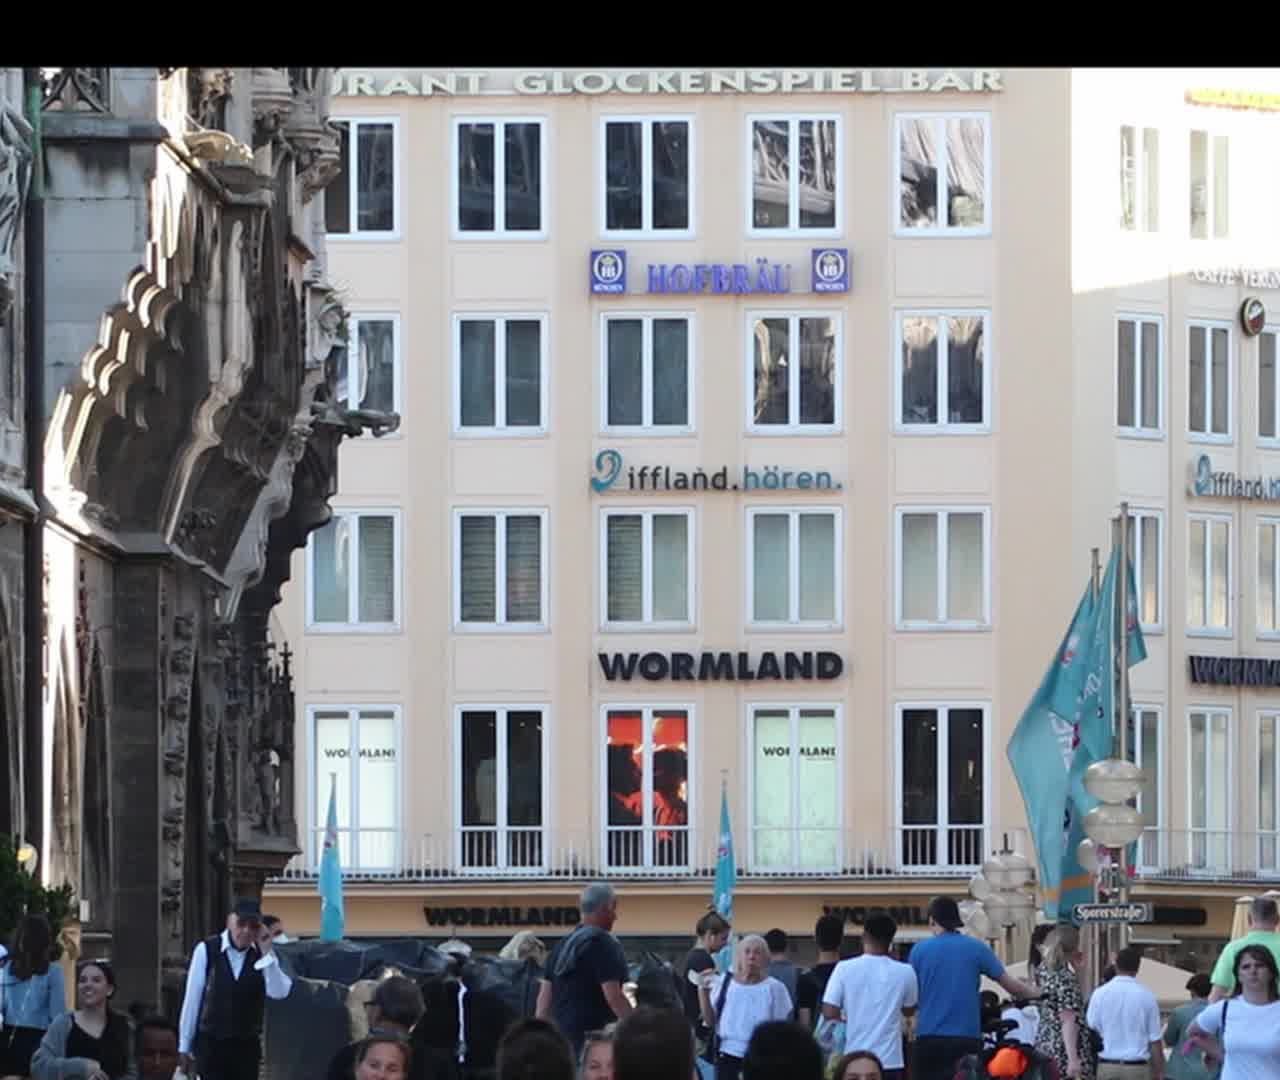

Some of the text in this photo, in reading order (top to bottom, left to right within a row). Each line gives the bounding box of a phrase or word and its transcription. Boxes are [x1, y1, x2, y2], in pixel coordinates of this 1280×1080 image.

[514, 70, 881, 95] GLOCKENSPIEL
[901, 69, 1005, 93] BAR
[646, 257, 793, 294] HOFBRÄU
[598, 651, 844, 682] WORMLAND
[424, 906, 582, 927] WORMLAND
